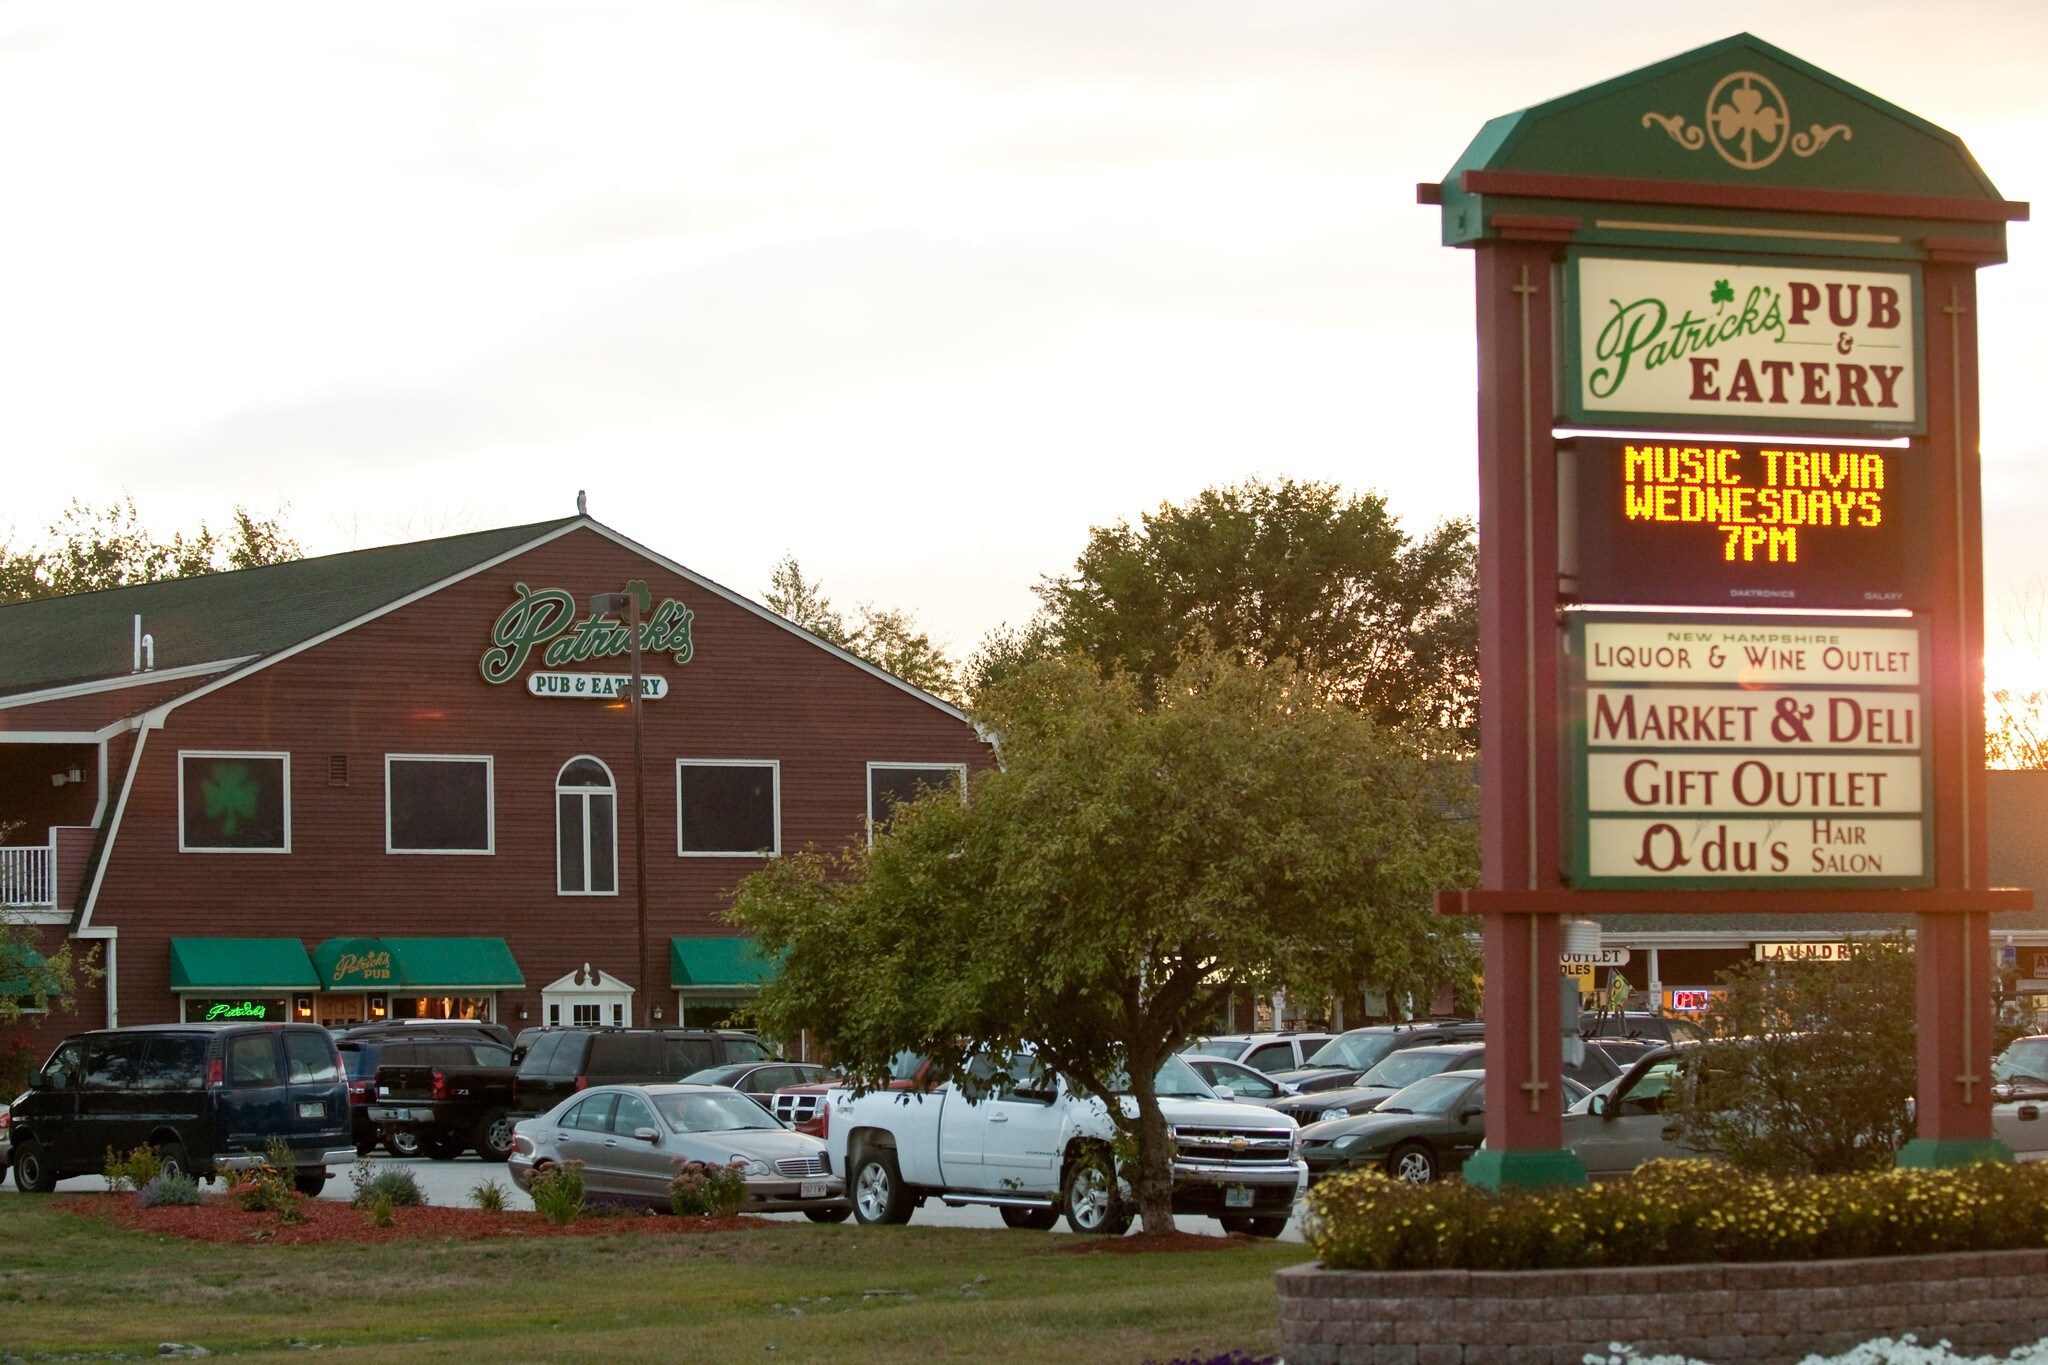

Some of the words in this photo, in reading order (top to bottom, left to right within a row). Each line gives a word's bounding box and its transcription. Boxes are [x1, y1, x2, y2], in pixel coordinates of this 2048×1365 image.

[1788, 281, 1901, 329] PUB
[1589, 286, 1786, 398] Patrick's
[1837, 332, 1854, 355] &
[1689, 357, 1904, 408] EATERY
[1624, 446, 1741, 485] MUSIC
[1760, 450, 1885, 489] TRIVIA
[1624, 485, 1882, 527] WEDNESDAYS
[1718, 525, 1797, 562] 7PM
[1730, 589, 1795, 599] DAKTRONICS
[1667, 631, 1714, 643] NEW
[1722, 632, 1841, 645] HAMPSHIRE
[1594, 643, 1692, 670] LIQUOR
[1708, 645, 1727, 669] &
[1743, 645, 1806, 671] WINE
[1822, 646, 1911, 673] OUTLET
[535, 676, 571, 693] PUB
[575, 678, 586, 692] &
[591, 677, 662, 695] EATRY
[1593, 694, 1758, 742] MARKET
[1771, 697, 1815, 743] &
[1828, 697, 1914, 744] DELI
[1623, 759, 1719, 806] GIFT
[1732, 760, 1888, 807] OUTLET
[1811, 819, 1867, 846] HAIR
[1811, 848, 1883, 873] SALON
[333, 951, 390, 980] Patrick's
[1560, 949, 1621, 962] OUTLET
[364, 969, 391, 979] PUB
